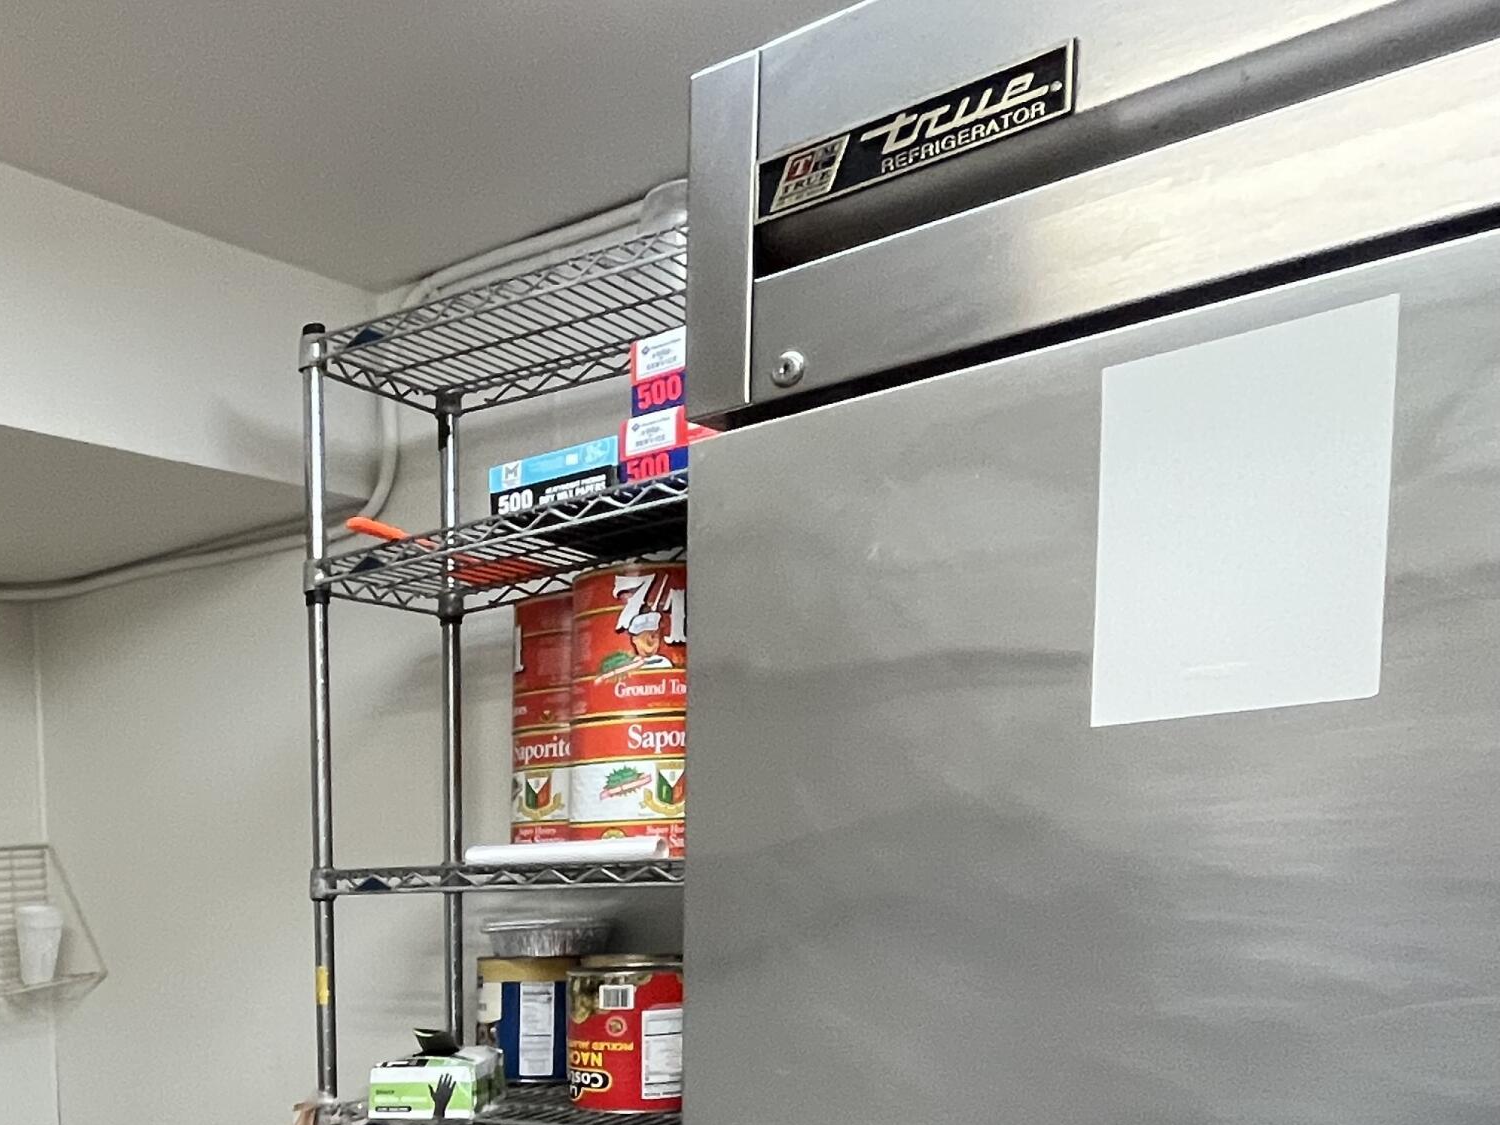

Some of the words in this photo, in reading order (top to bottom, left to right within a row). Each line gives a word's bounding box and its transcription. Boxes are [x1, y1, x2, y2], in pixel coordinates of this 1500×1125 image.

[880, 101, 1046, 174] REFRIGERATOR
[637, 374, 682, 409] 500
[627, 452, 669, 481] 500
[498, 489, 533, 515] 500
[614, 680, 666, 698] Ground
